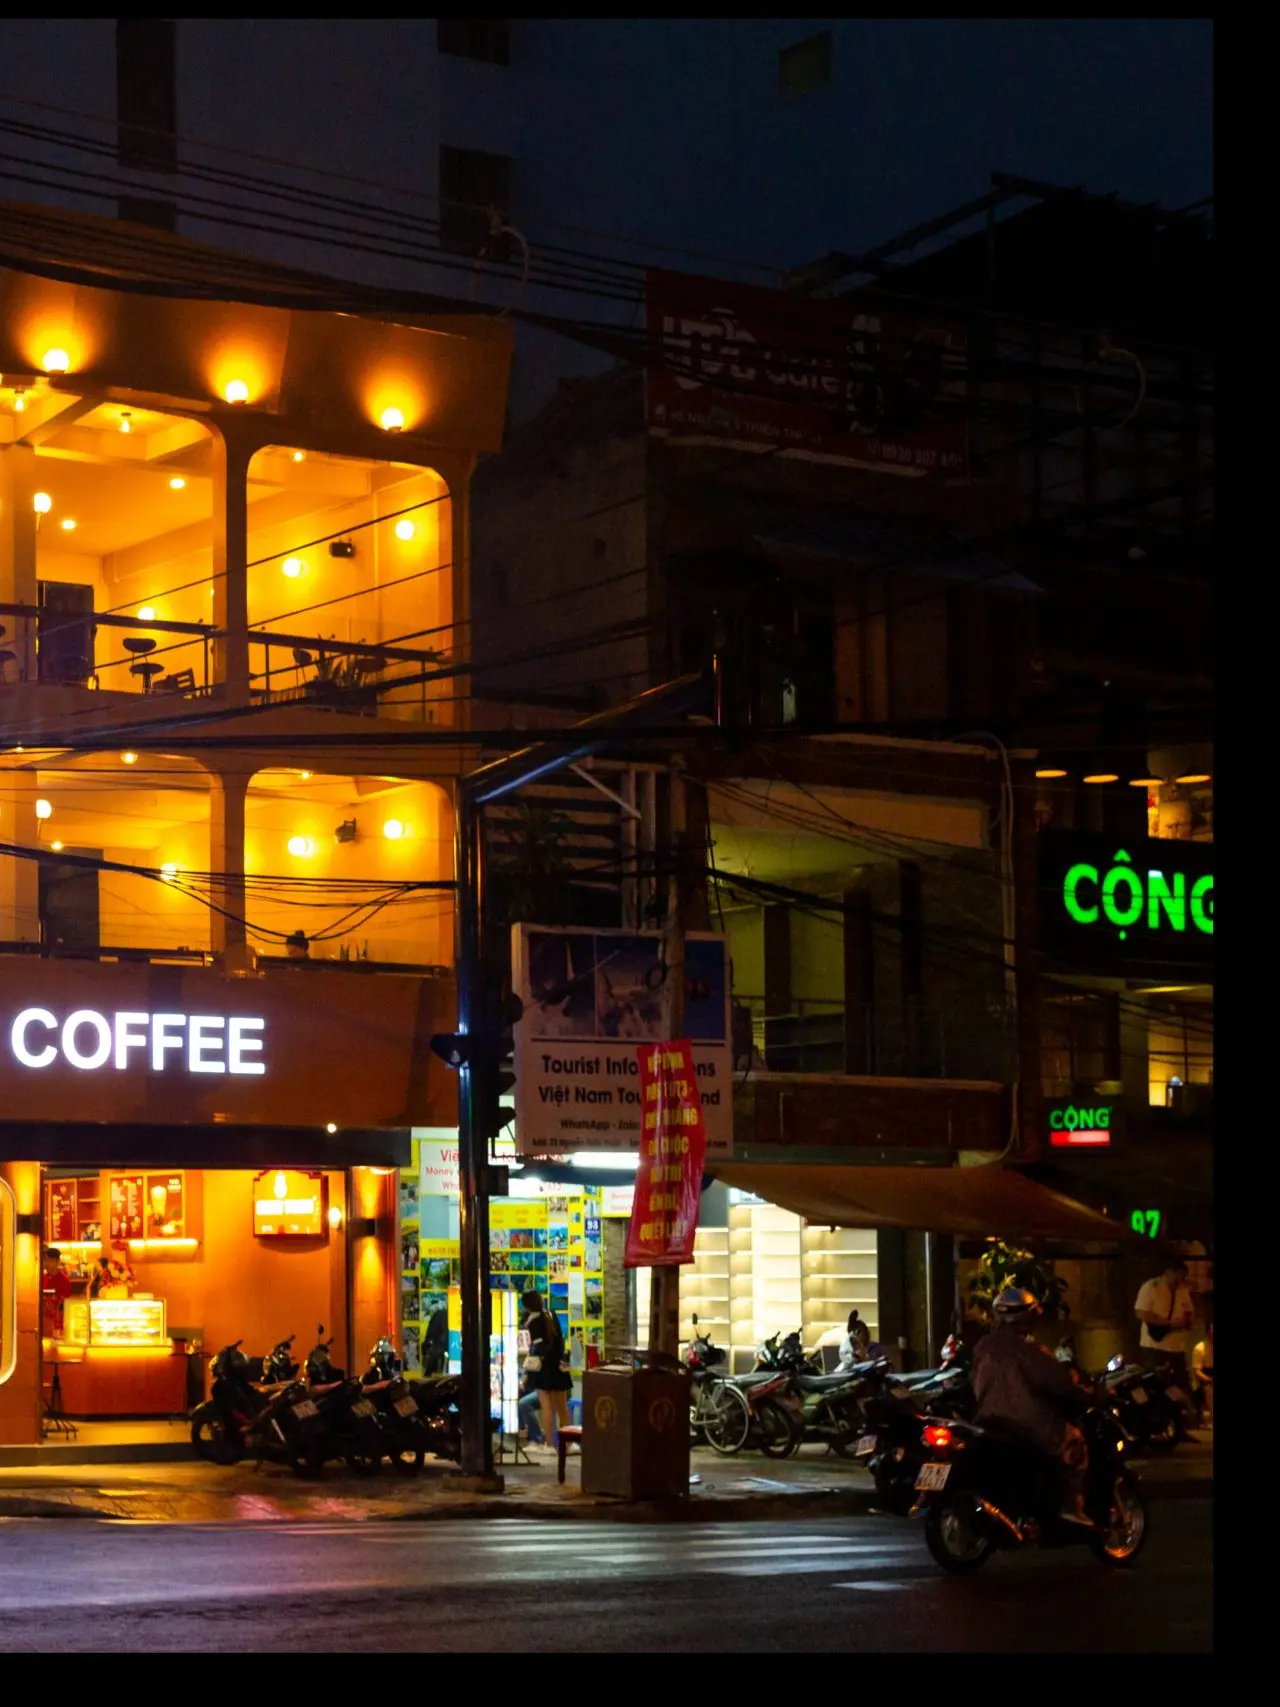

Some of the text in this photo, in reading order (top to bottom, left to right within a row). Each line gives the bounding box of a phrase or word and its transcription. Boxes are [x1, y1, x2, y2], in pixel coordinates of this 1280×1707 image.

[1064, 849, 1213, 940] CỘNG
[11, 1007, 265, 1074] COFFEE
[542, 1055, 600, 1074] Tourist
[539, 1086, 570, 1107] Việt
[575, 1088, 613, 1104] Nam
[1050, 1105, 1109, 1132] CỘNG
[1131, 1210, 1161, 1240] 97
